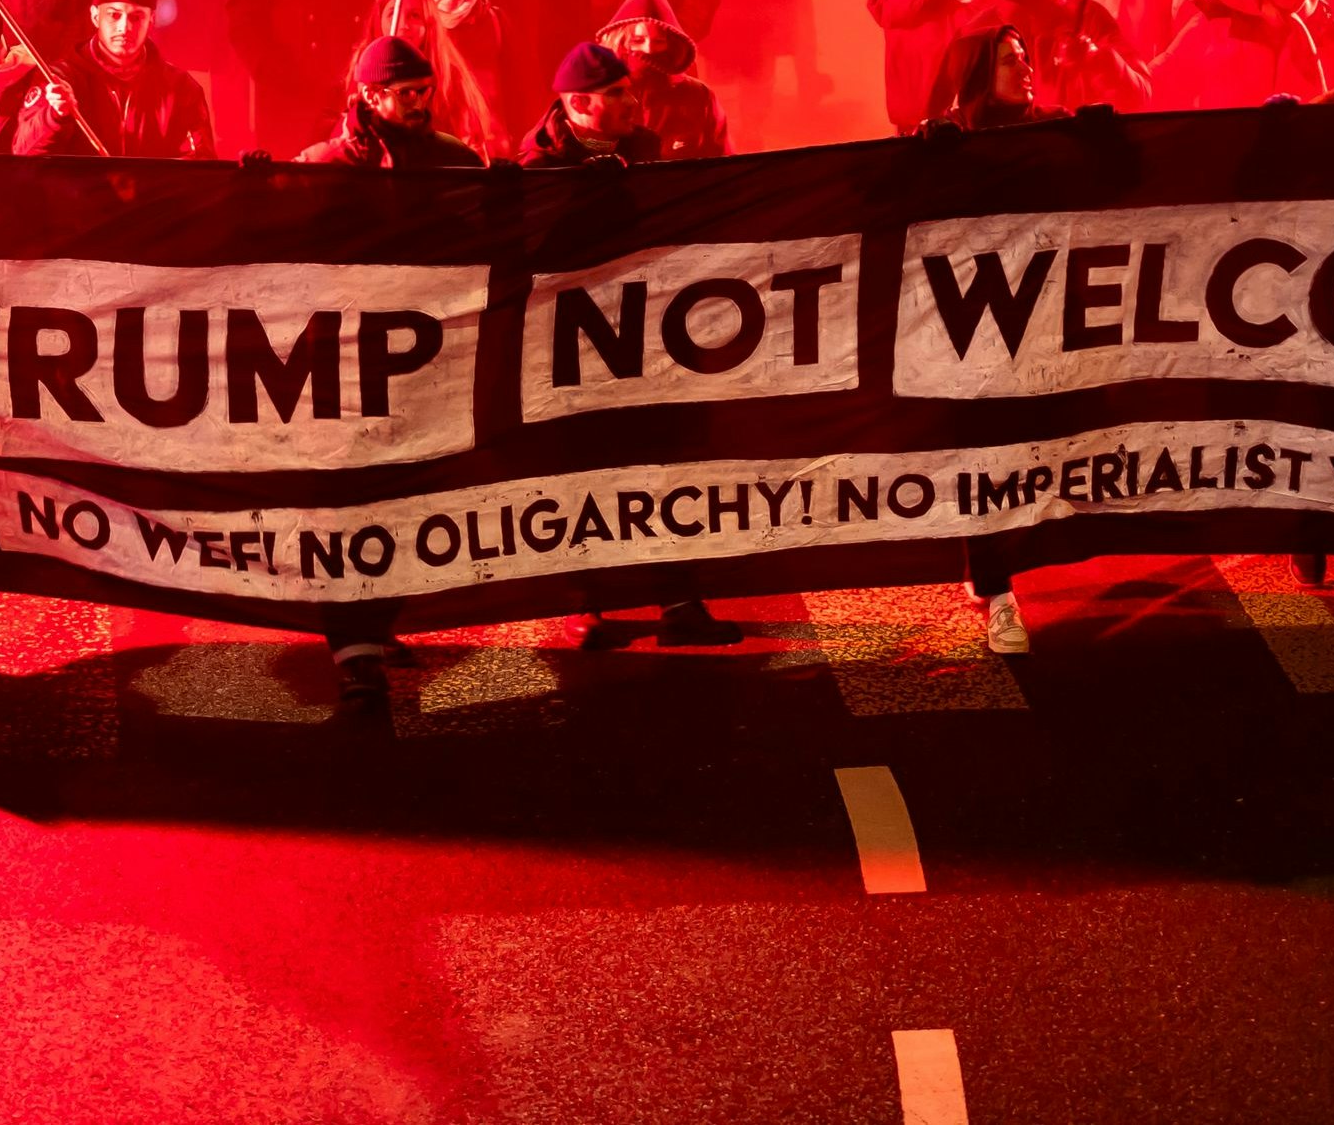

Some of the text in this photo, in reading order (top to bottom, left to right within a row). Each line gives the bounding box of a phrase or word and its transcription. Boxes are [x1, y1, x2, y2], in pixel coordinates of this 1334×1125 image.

[551, 263, 843, 389] NOT
[17, 490, 111, 551] NO
[299, 524, 397, 579] NO
[414, 478, 815, 568] OLIGARCHY!
[837, 473, 937, 524] NO
[957, 442, 1314, 514] IMPERIALIST
